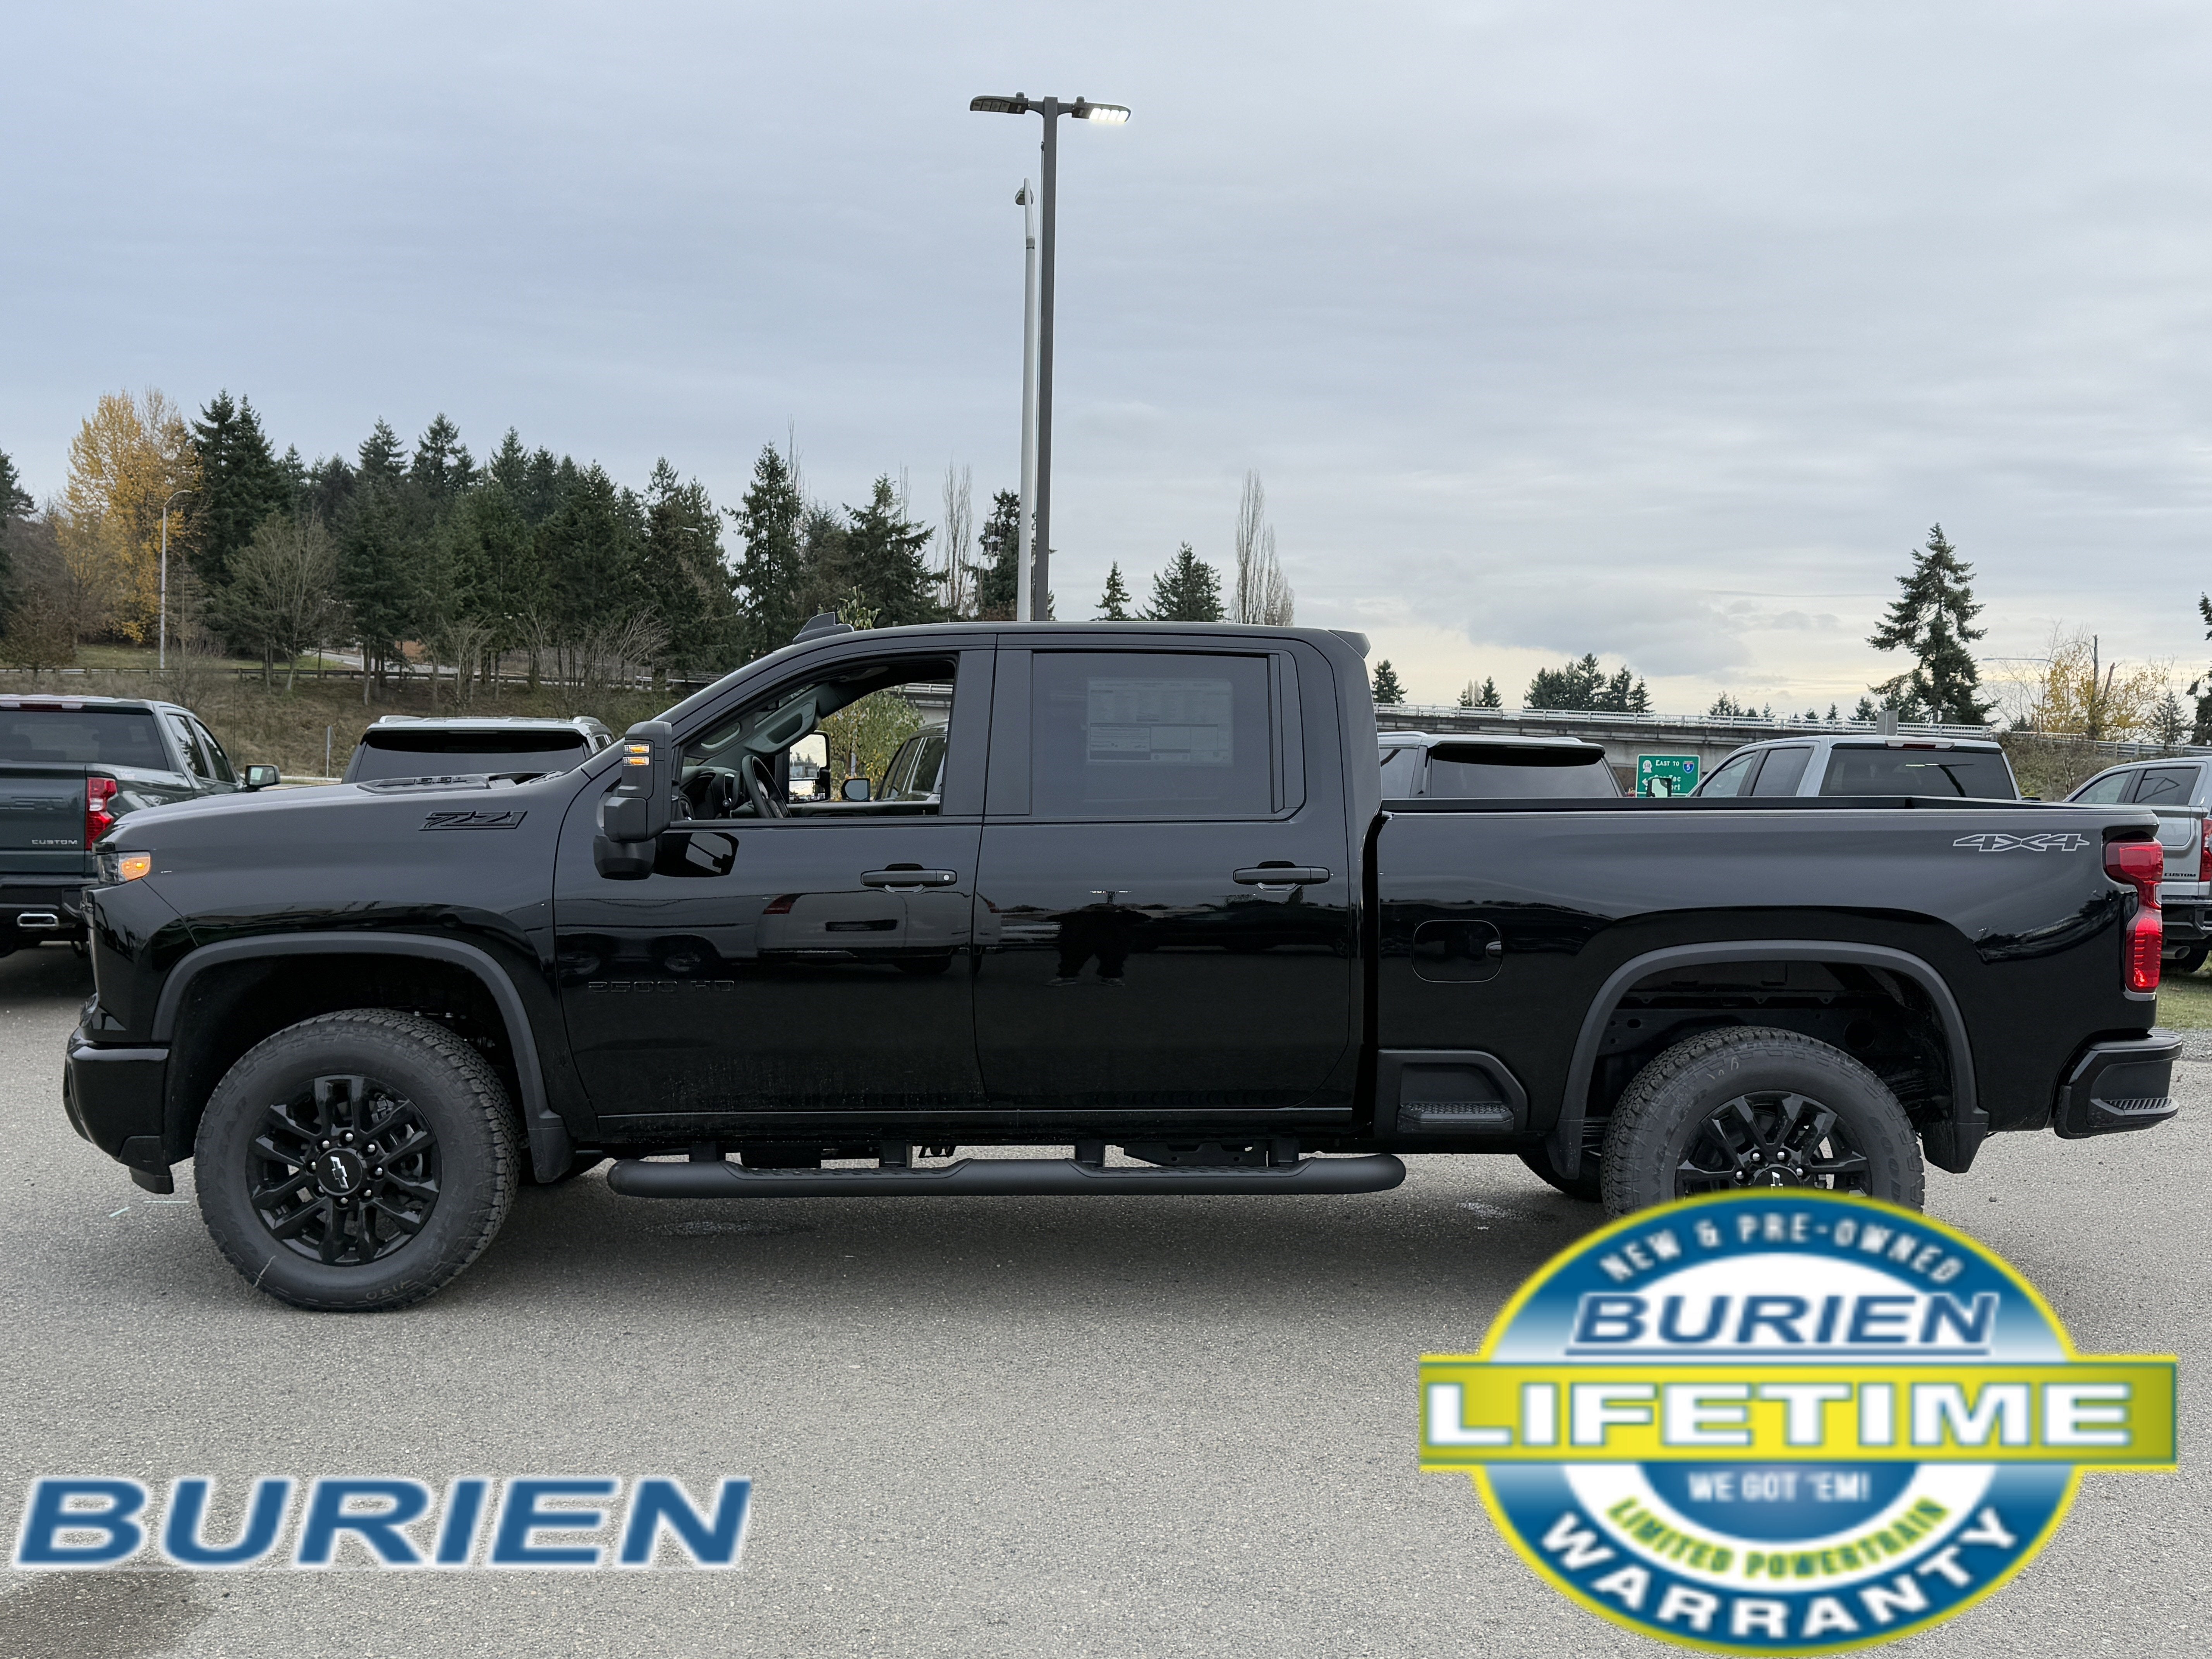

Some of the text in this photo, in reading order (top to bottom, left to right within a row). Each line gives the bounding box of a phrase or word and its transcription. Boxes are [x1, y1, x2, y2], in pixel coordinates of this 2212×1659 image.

[418, 811, 527, 831] Z71
[588, 981, 734, 992] 2500 HD
